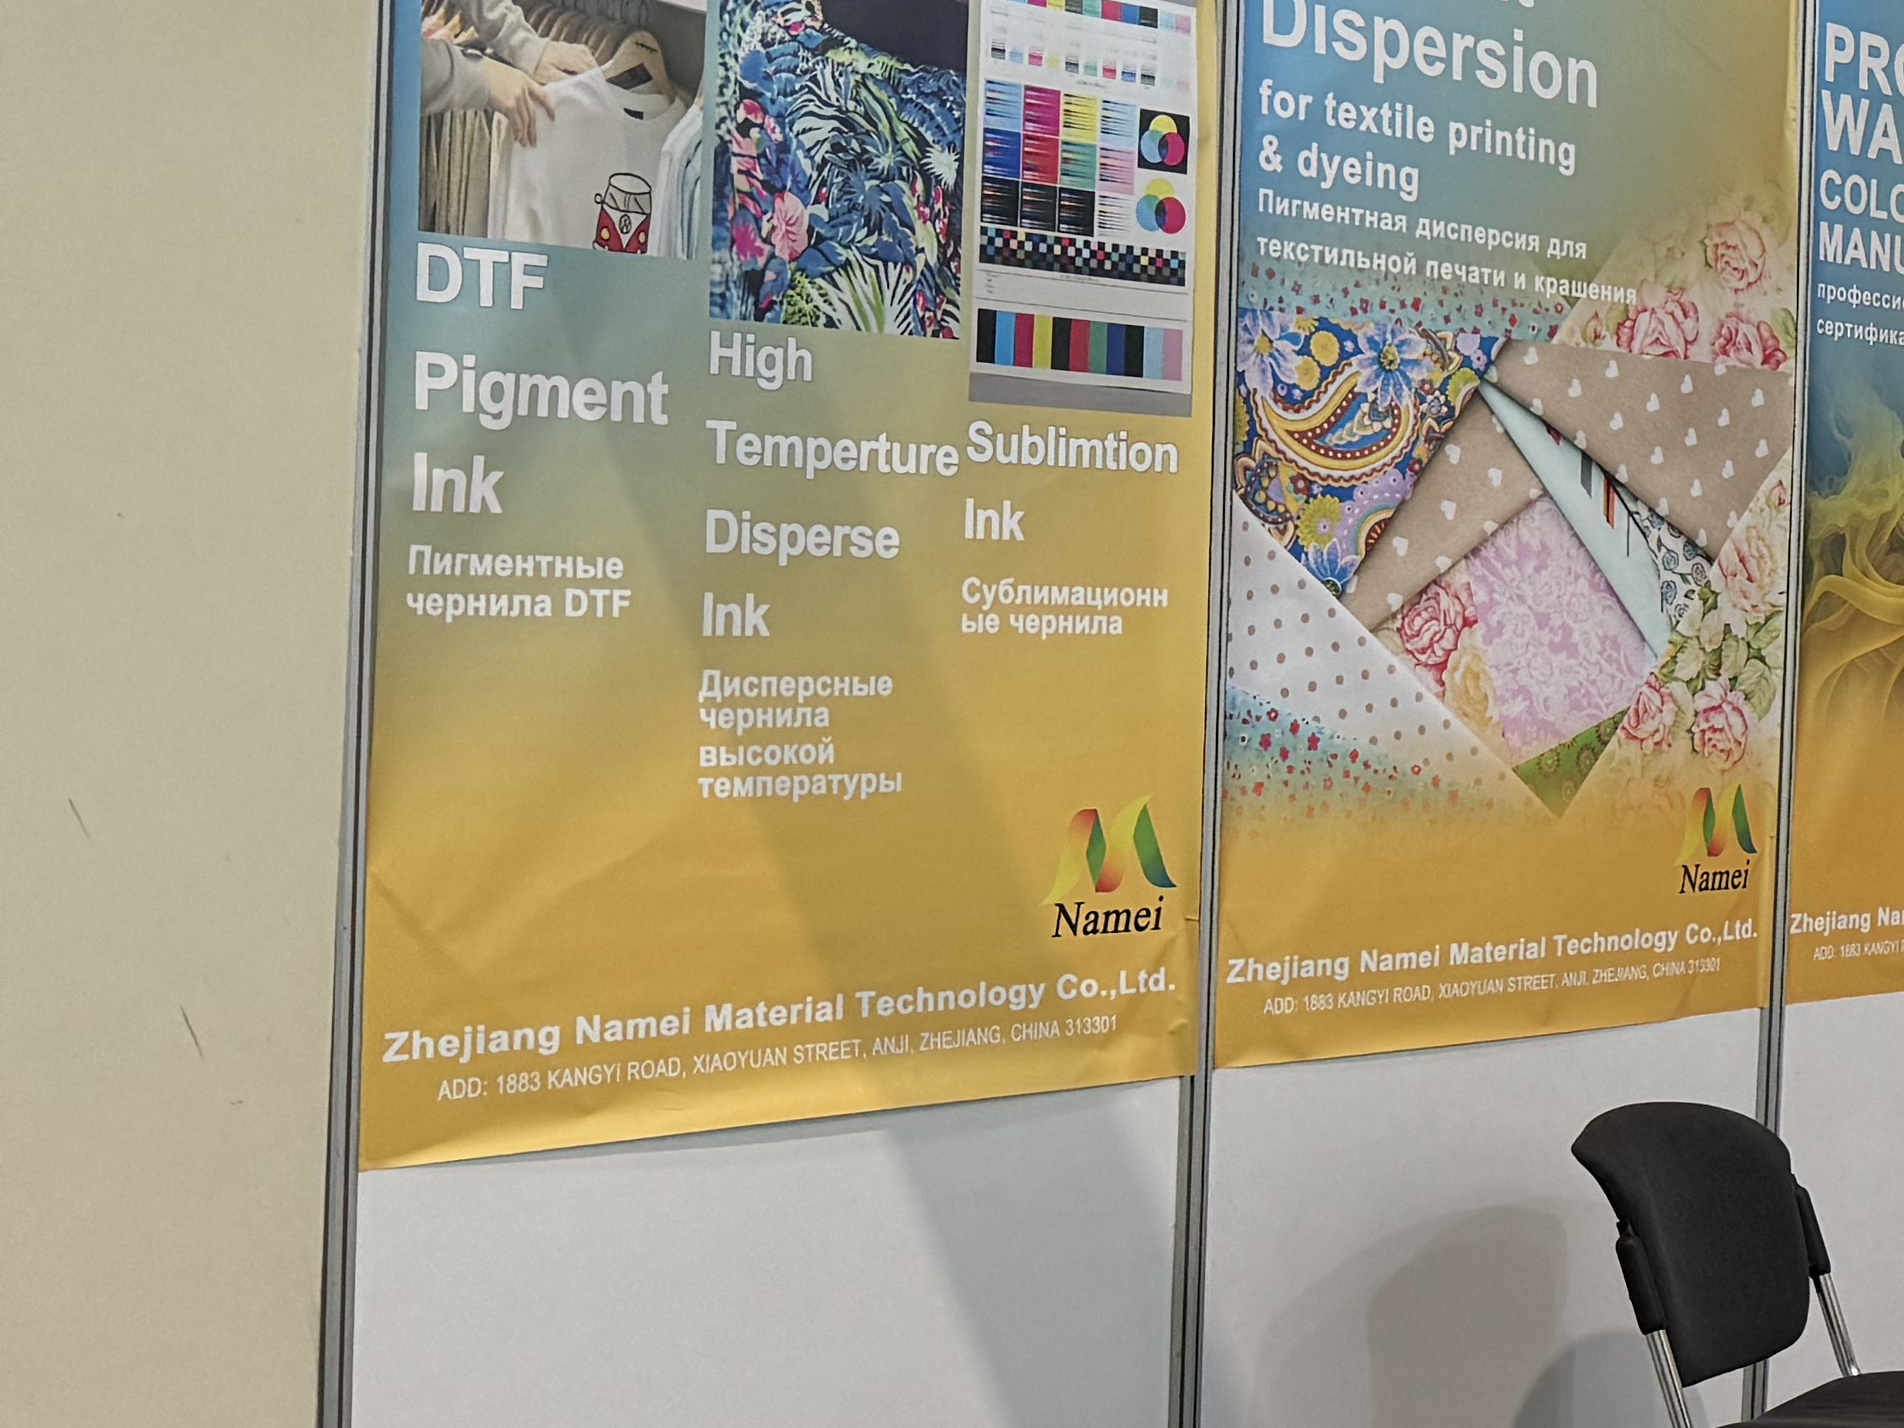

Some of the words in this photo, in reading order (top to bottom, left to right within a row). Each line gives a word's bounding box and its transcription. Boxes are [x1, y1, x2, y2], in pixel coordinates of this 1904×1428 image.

[1259, 79, 1312, 121] for
[1325, 91, 1435, 142] textile
[1448, 118, 1577, 176] printing
[1259, 135, 1283, 171] &
[1297, 143, 1420, 202] dyeing
[1258, 188, 1407, 233] Пигментная
[1416, 217, 1540, 254] дисперсия
[1547, 235, 1587, 259] для
[415, 243, 549, 311] DTF
[1258, 236, 1417, 275] текстильной
[1426, 260, 1505, 287] печати
[1514, 269, 1526, 289] и
[1534, 272, 1637, 306] крашения
[708, 331, 814, 391] High
[413, 351, 670, 431] Pigment
[706, 420, 959, 480] Temperture
[966, 421, 1180, 474] Sublimtion
[412, 453, 504, 515] Ink
[704, 509, 901, 565] Disperse
[964, 498, 1025, 543] Ink
[408, 545, 624, 581] Пигментные
[406, 590, 552, 623] чернила
[564, 589, 631, 619] DTF
[701, 592, 770, 639] Ink
[960, 578, 1168, 611] Сублимационн
[960, 612, 998, 634] ые
[1008, 612, 1123, 640] чернила
[698, 669, 893, 701] Дисперсные
[699, 704, 830, 734] чернила
[699, 739, 835, 768] высокой
[697, 772, 903, 803] температуры
[1678, 860, 1751, 895] Namei
[1052, 896, 1164, 938] Namei
[1790, 910, 1871, 936] Zhejiang
[1226, 955, 1350, 986] Zhejiang
[1360, 945, 1440, 973] Namei
[1449, 936, 1546, 966] Material
[1553, 928, 1679, 957] Technology
[1685, 918, 1757, 946] Co.,Ltd.
[1264, 996, 1298, 1015] ADD:
[1303, 994, 1333, 1011] 1883
[1338, 988, 1389, 1009] KANGYI
[1438, 978, 1505, 999] XIAOYUAN
[1653, 962, 1686, 978] CHINA
[383, 1024, 560, 1064] Zhejiang
[575, 1006, 691, 1045] Namei
[704, 994, 843, 1032] Material
[855, 981, 1046, 1018] Technology
[1056, 967, 1175, 1000] Co.,Ltd.
[438, 1077, 488, 1101] ADD:
[497, 1072, 541, 1094] 1883
[548, 1064, 620, 1090] KANGYI
[627, 1056, 686, 1081] ROAD,
[693, 1047, 787, 1075] XIAOYUAN
[793, 1039, 867, 1065] STREET,
[1011, 1020, 1060, 1042] CHINA
[1065, 1015, 1117, 1037] 313301
